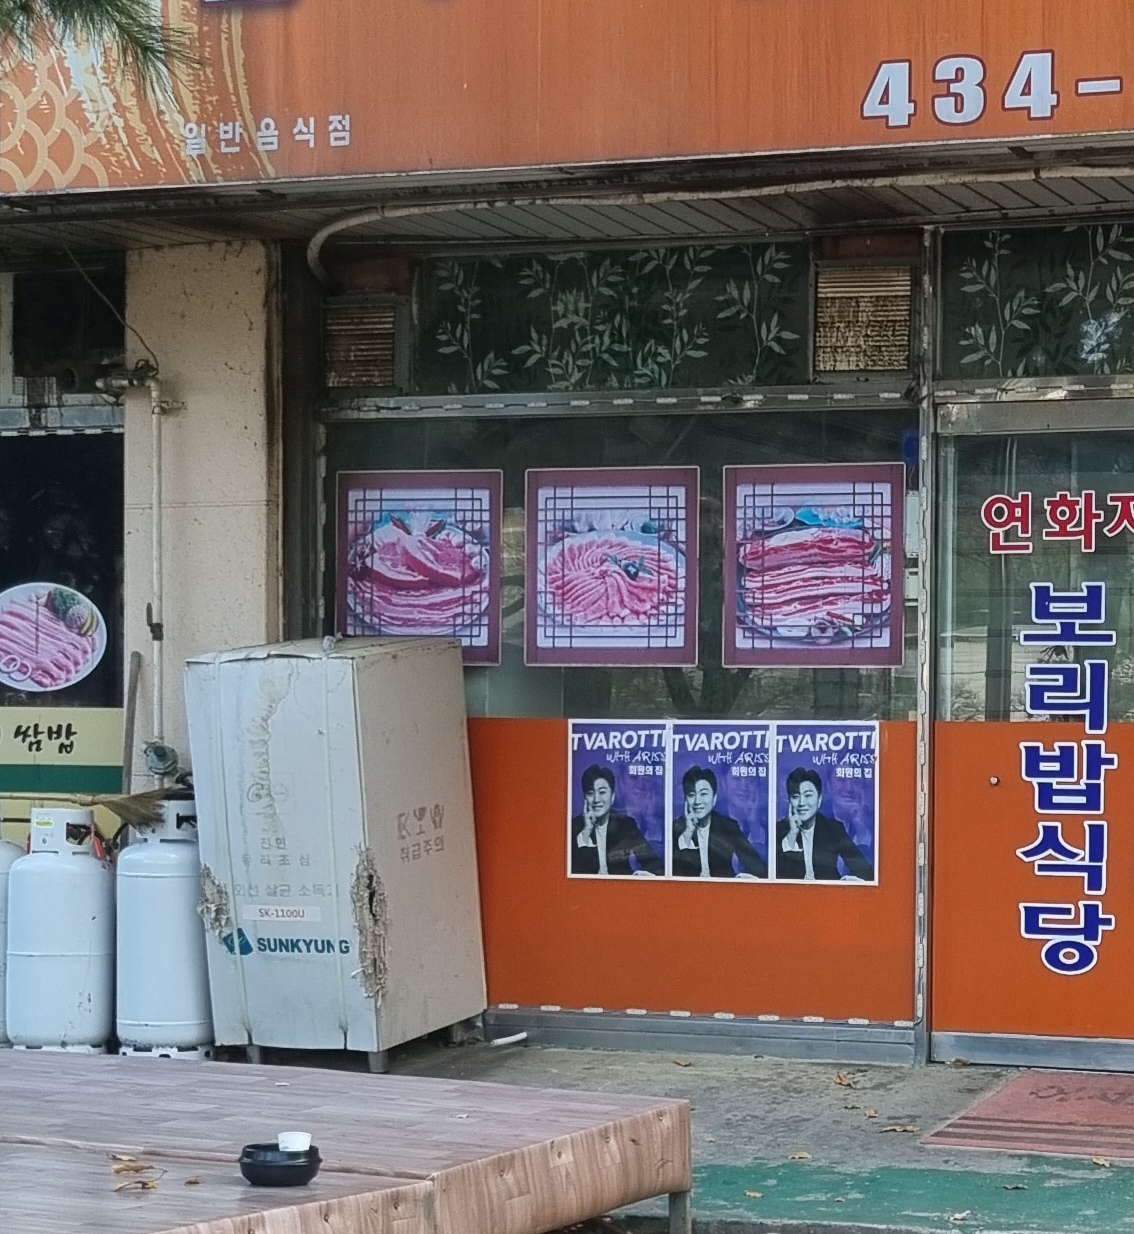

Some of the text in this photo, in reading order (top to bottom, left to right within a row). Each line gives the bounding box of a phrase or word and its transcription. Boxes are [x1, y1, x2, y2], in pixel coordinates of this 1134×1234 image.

[184, 114, 351, 156] 일반음식점
[13, 722, 78, 755] 쌈밥
[400, 835, 445, 864] 취급주의
[258, 908, 306, 919] SK-1100U
[257, 936, 350, 955] SUNKYUNG
